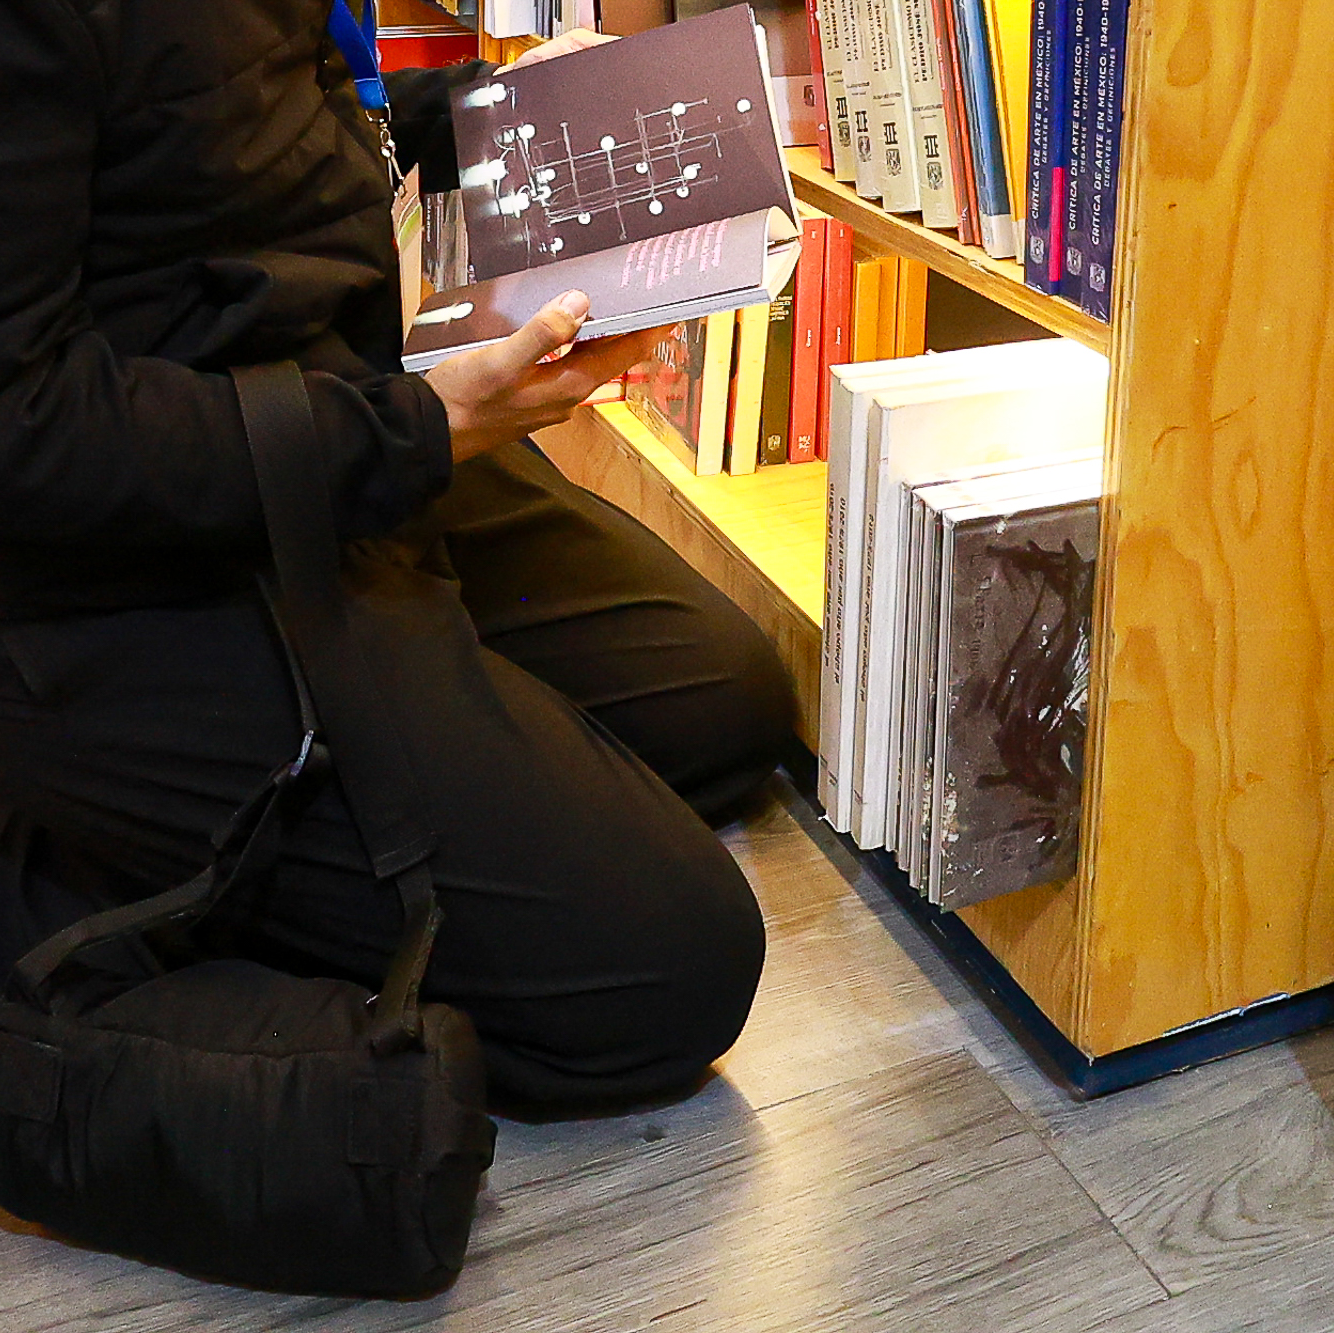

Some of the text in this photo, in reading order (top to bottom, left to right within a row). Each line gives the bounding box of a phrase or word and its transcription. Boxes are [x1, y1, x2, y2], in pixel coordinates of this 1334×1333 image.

[1035, 90, 1043, 108] EN
[1072, 99, 1081, 117] EN
[1033, 112, 1042, 145] ARTE
[1095, 111, 1105, 129] EN
[1070, 121, 1080, 155] ARTE
[1094, 133, 1104, 168] ARTE
[1033, 148, 1041, 166] DE
[1069, 158, 1078, 176] DE
[1093, 171, 1103, 190] DE
[1031, 169, 1040, 219] CRÍTICA
[1067, 179, 1077, 230] CRÍTICA
[1091, 194, 1102, 245] CRÍTICA
